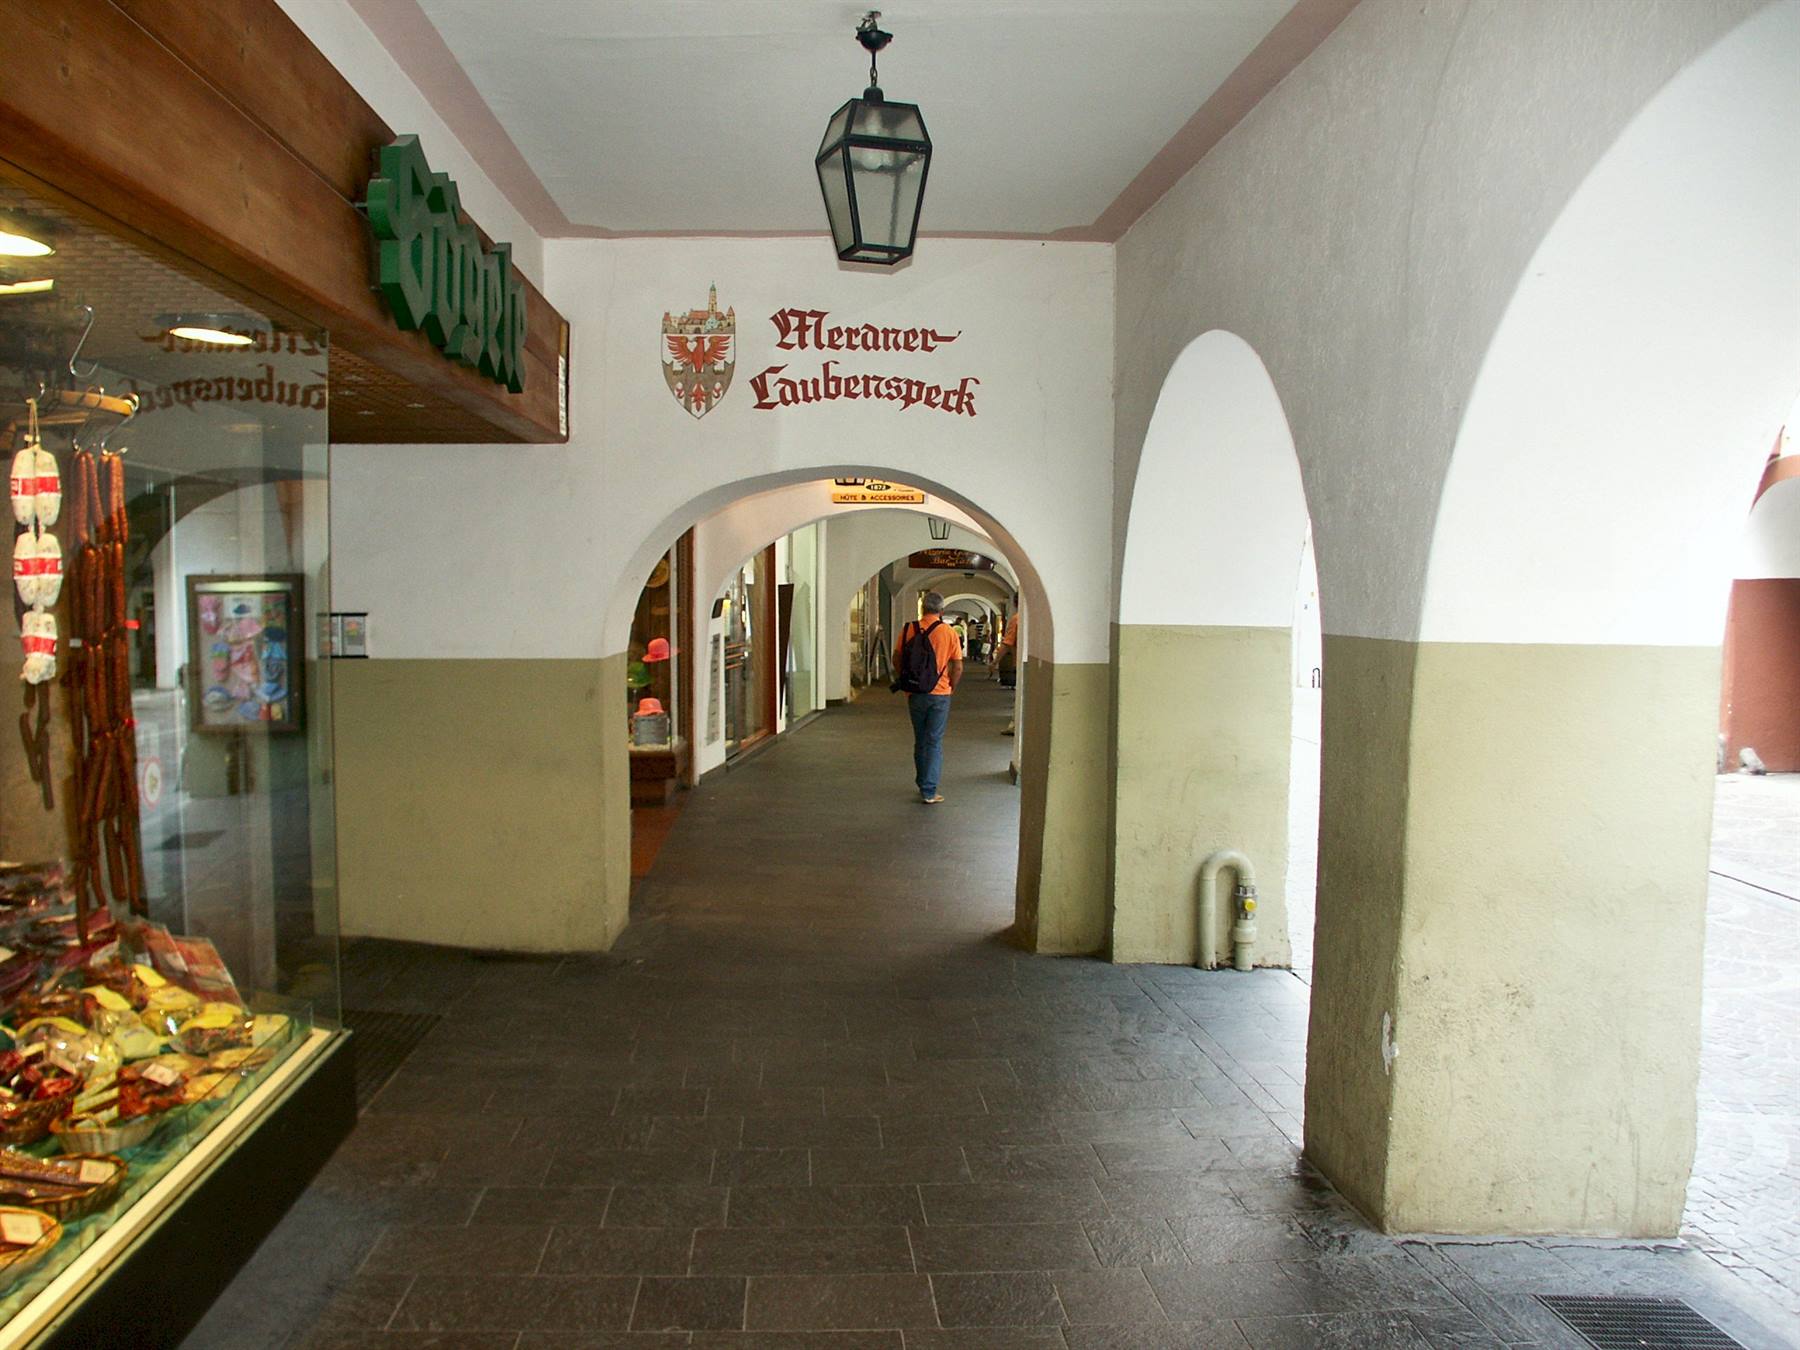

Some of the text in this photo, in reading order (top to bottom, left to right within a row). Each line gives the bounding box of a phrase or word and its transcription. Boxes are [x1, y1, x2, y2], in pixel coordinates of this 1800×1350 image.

[770, 308, 962, 352] Meraner
[749, 360, 980, 417] Laubenspeck
[870, 493, 914, 501] ACCESSOIRES
